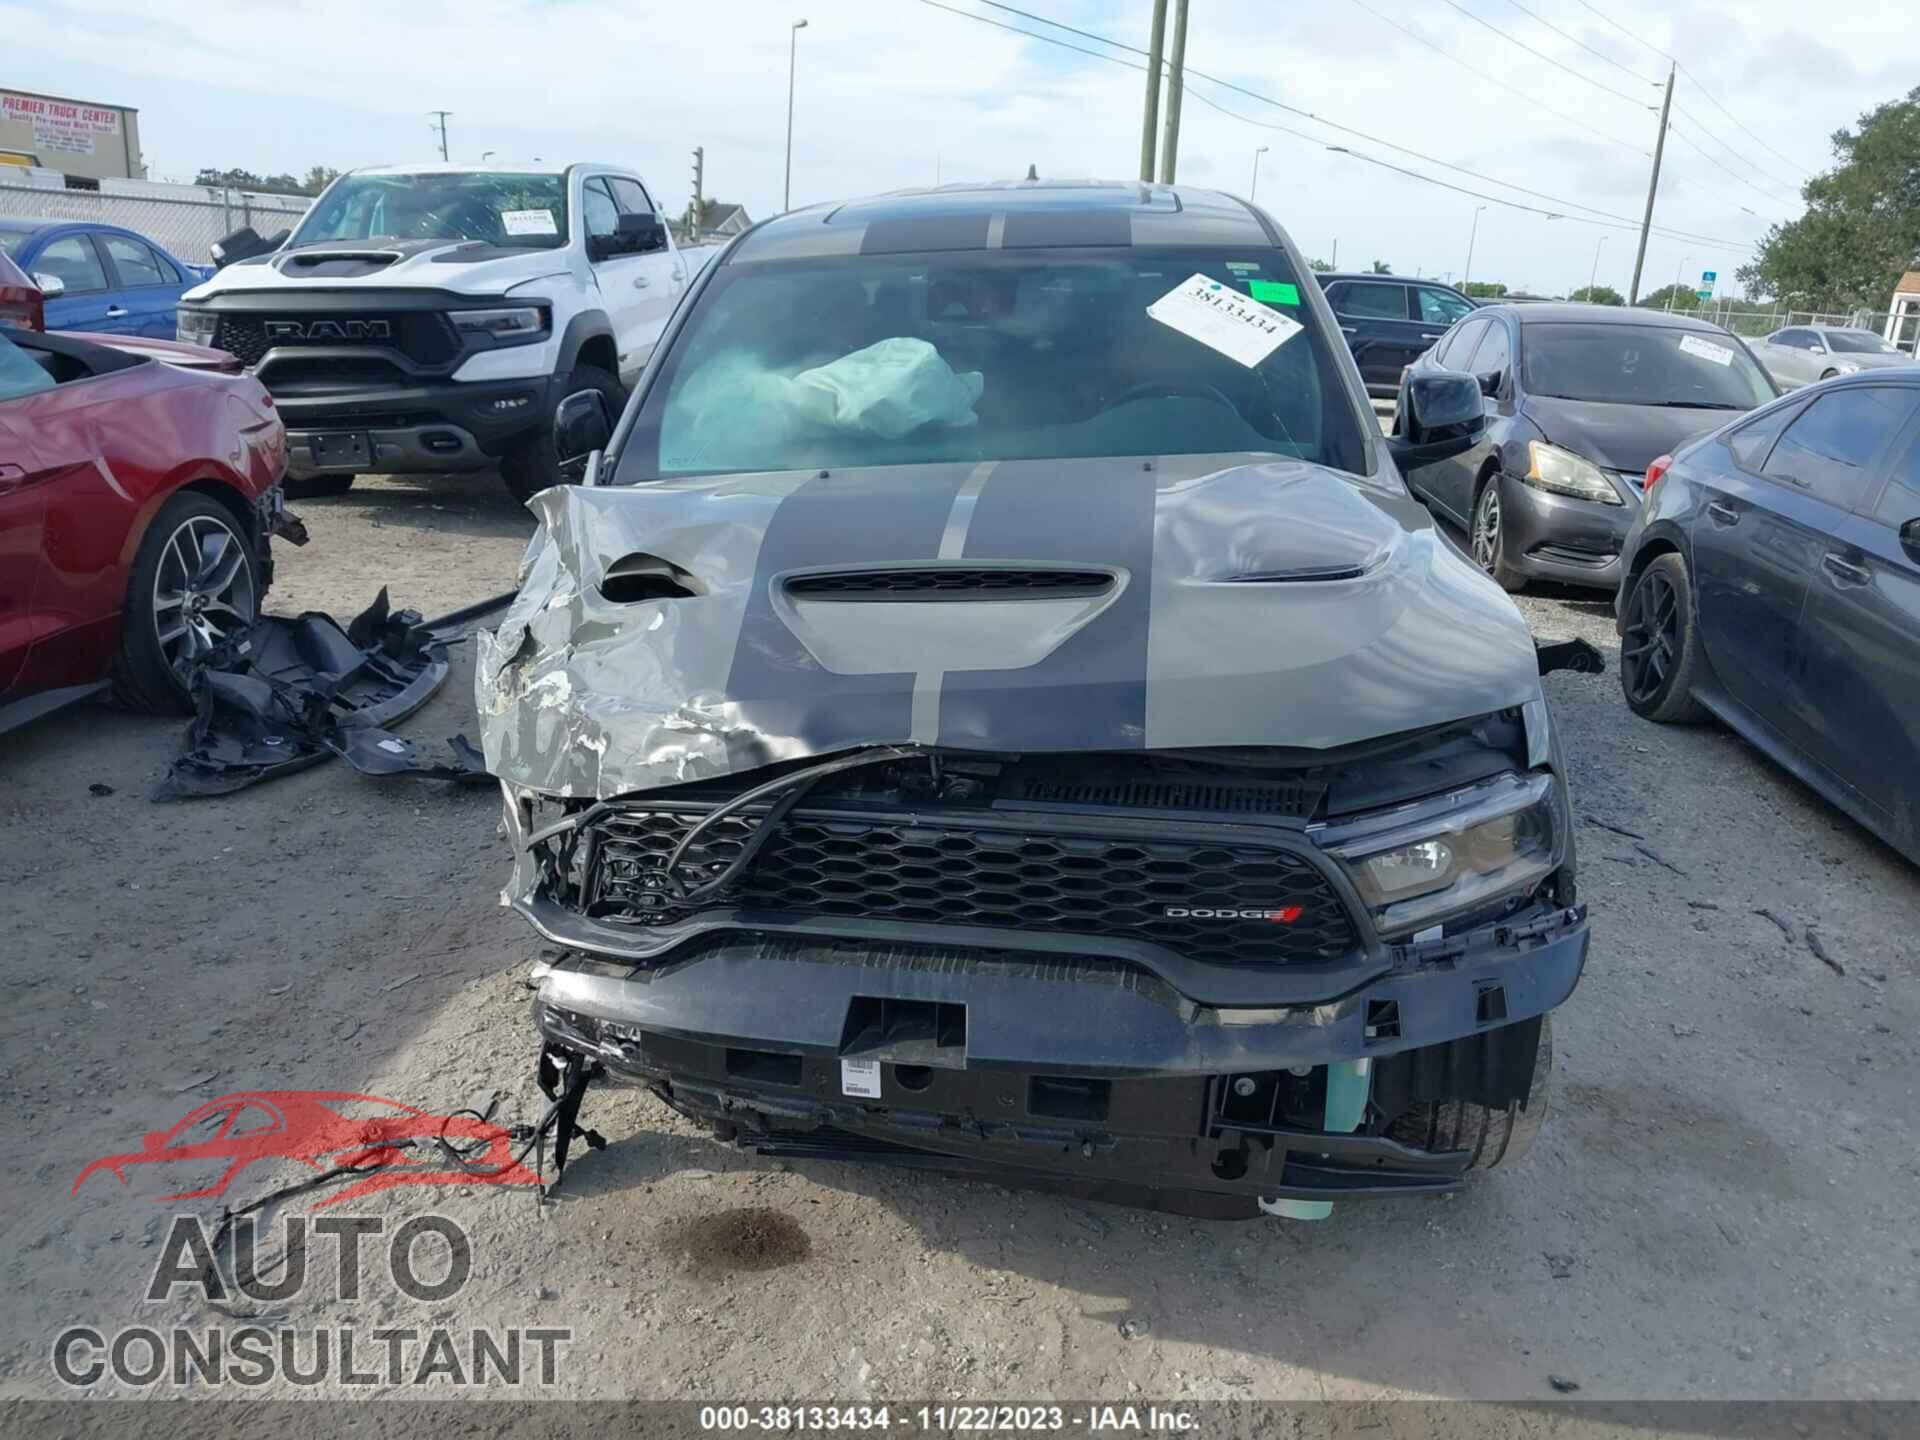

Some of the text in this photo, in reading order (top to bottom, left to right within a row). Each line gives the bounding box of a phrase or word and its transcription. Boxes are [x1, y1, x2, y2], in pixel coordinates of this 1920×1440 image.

[3, 97, 116, 123] PREMIER TRUCK CENTER
[1188, 288, 1278, 334] 38133434
[264, 320, 390, 338] RAM
[1166, 908, 1284, 919] DODGE
